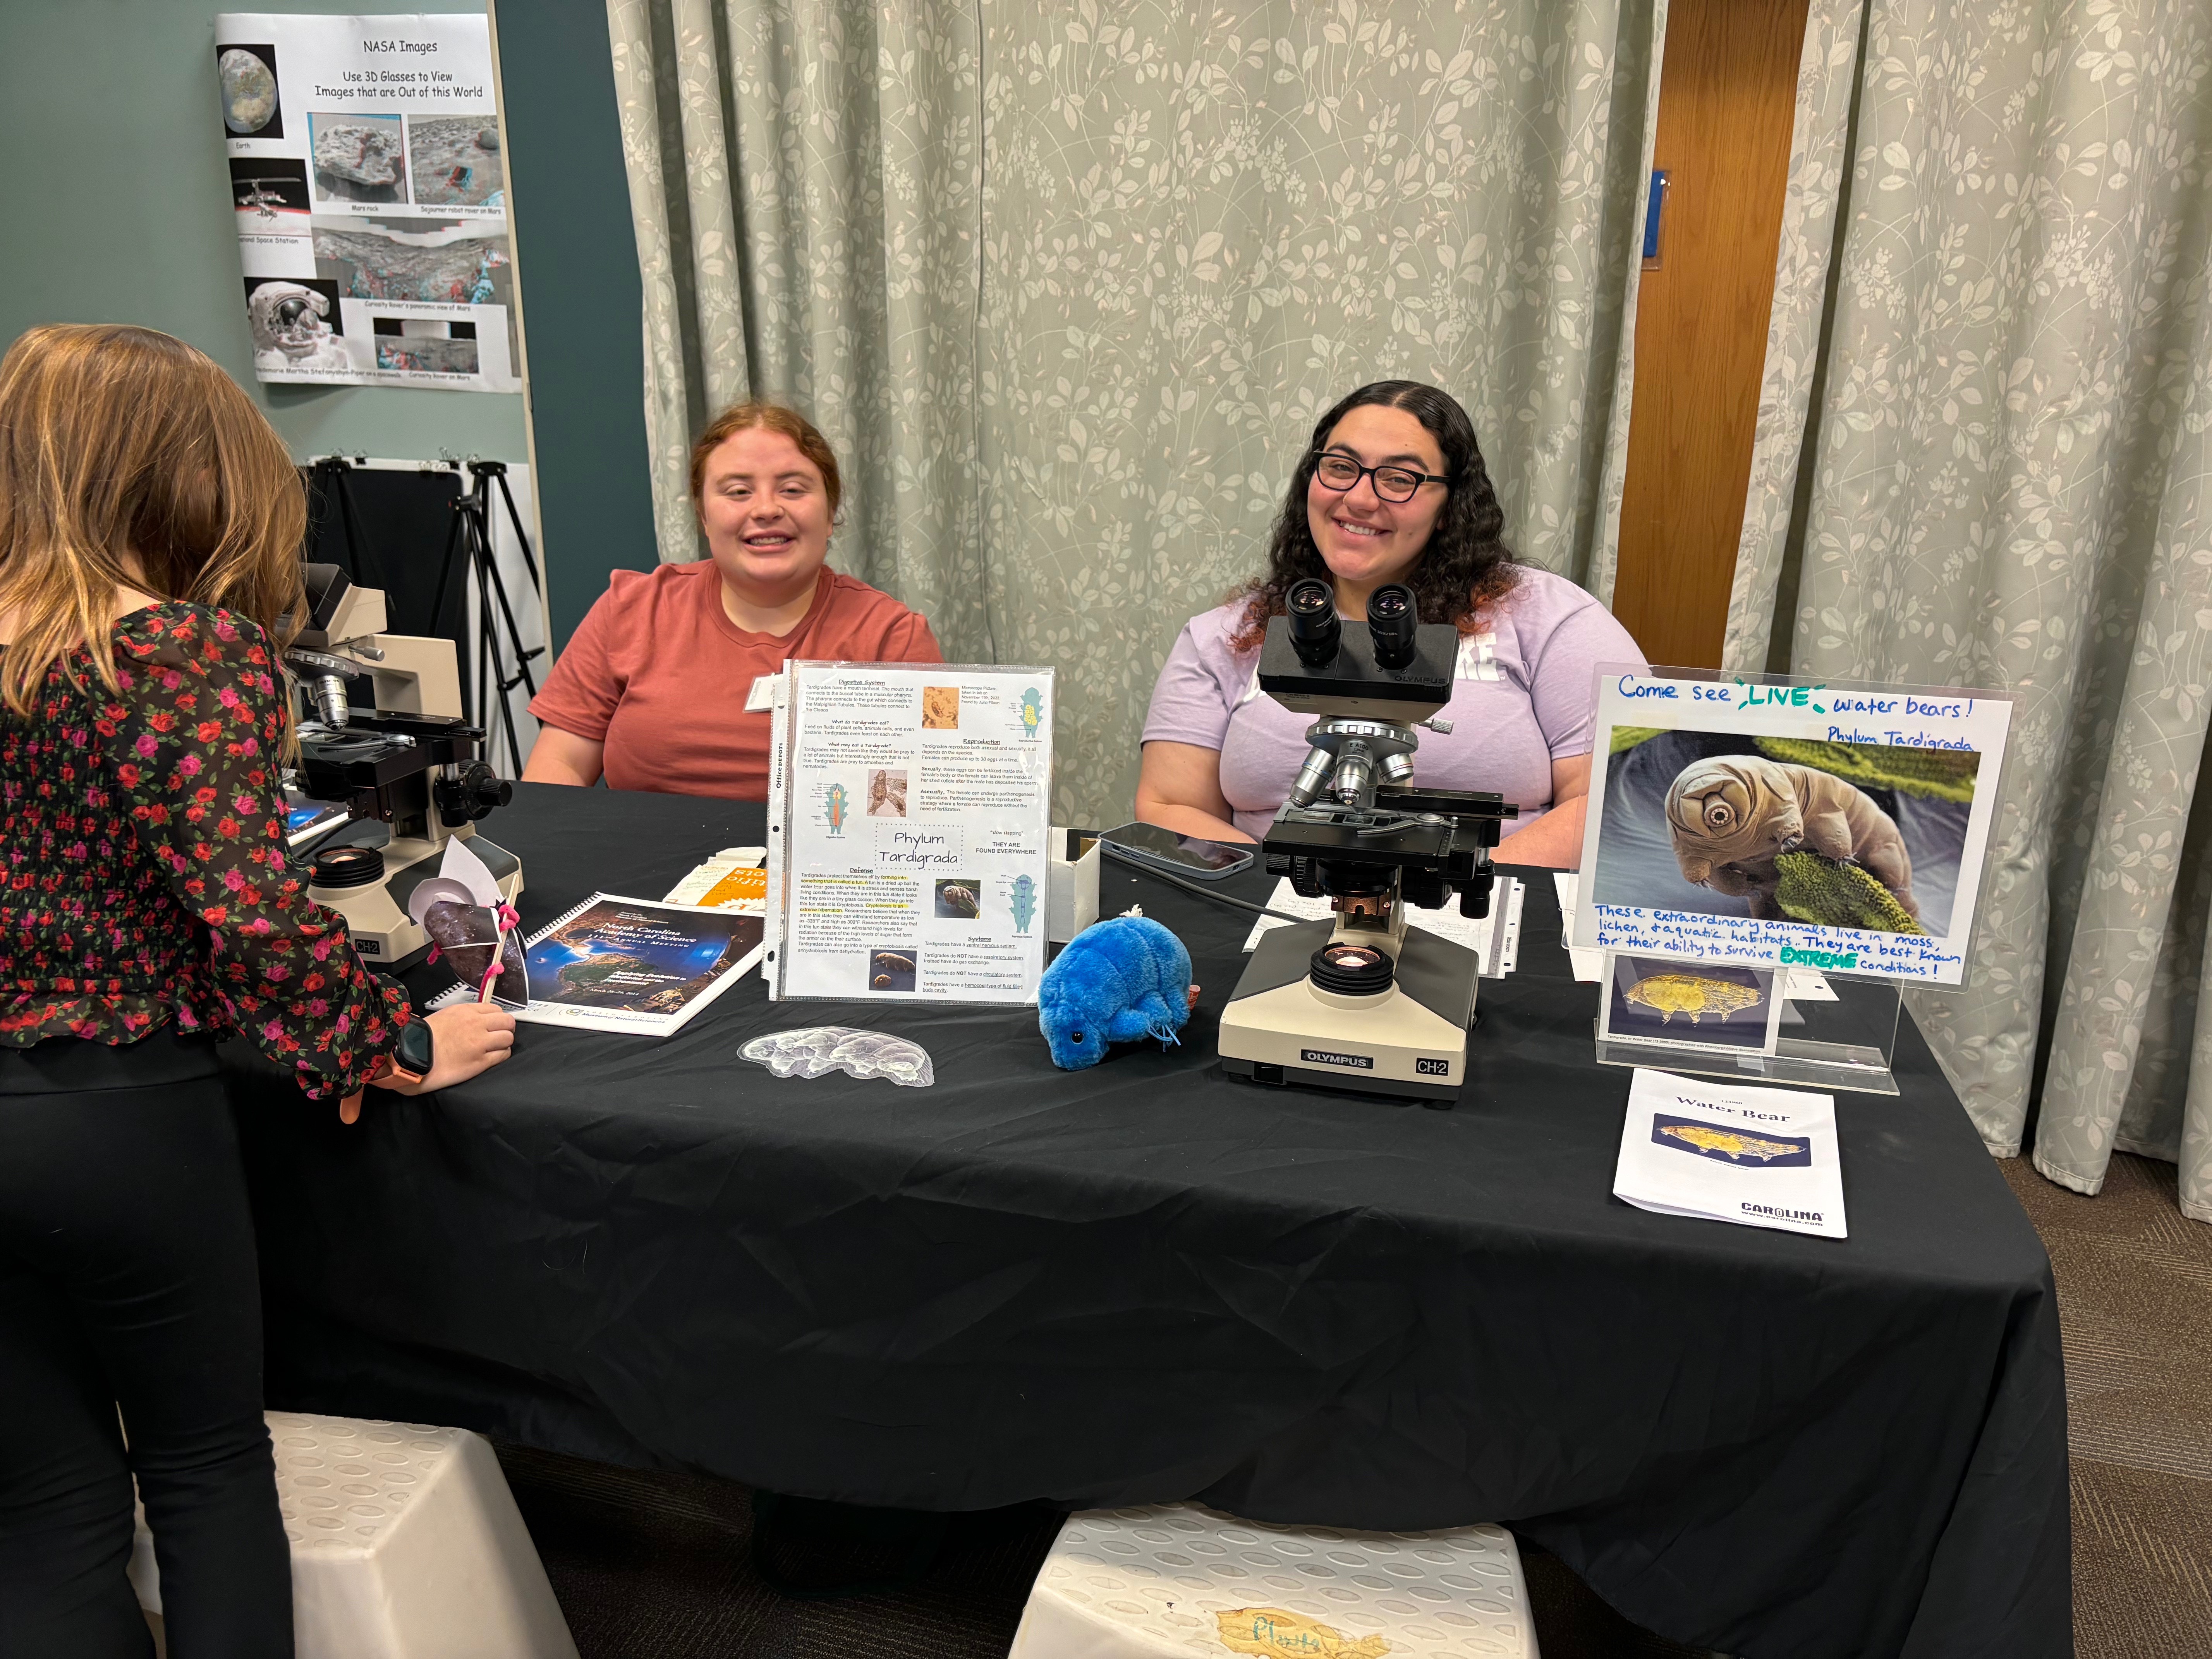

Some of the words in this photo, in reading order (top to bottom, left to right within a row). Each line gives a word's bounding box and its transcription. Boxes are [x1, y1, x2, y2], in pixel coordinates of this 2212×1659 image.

[364, 41, 396, 52] NASA
[399, 40, 437, 55] Images
[343, 71, 362, 82] Use
[366, 71, 378, 82] 3D
[381, 71, 415, 82] Glasses
[419, 72, 428, 82] to
[431, 71, 452, 82] View
[315, 86, 354, 99] Images
[357, 87, 376, 97] that
[380, 89, 395, 97] are
[398, 86, 416, 98] Out
[419, 86, 429, 98] of
[432, 87, 450, 97] this
[453, 86, 483, 97] World
[1395, 676, 1446, 684] OLYMPUS
[1618, 674, 1678, 698] Come
[1693, 686, 1731, 701] see
[1749, 685, 1811, 707] LIVE
[1833, 698, 1898, 715] water
[1906, 697, 1973, 718] bears!
[1828, 726, 1877, 748] Phylum
[1884, 730, 1974, 752] Tardigrada
[895, 832, 944, 849] Phylum
[879, 849, 958, 869] Tardigrada
[594, 927, 643, 938] Academy
[603, 922, 634, 931] North
[637, 927, 681, 936] Carolina
[1595, 905, 1642, 917] These
[1654, 910, 1759, 933] extraordinary
[1765, 920, 1827, 936] animals
[1836, 927, 1862, 940] live
[1870, 932, 1882, 941] in
[1896, 936, 1939, 951] moss,
[356, 941, 378, 952] CH-2
[1599, 919, 1645, 936] lichen,
[1665, 926, 1721, 939] aquatic
[1803, 936, 1843, 953] They
[1846, 945, 1872, 953] are
[1879, 945, 1911, 958] best
[1597, 933, 1619, 946] for
[1626, 936, 1661, 948] their
[1664, 939, 1704, 957] ability
[1709, 943, 1722, 955] to
[1726, 945, 1774, 959] survive
[1780, 947, 1859, 969] EXTREME
[1306, 1052, 1367, 1068] OLYMPUS
[1417, 1061, 1447, 1075] CH-2
[1675, 1096, 1736, 1113] Water
[1742, 1109, 1790, 1122] Bear
[1741, 1202, 1822, 1221] CAROLINA
[1741, 1211, 1823, 1226] www.carolina.com
